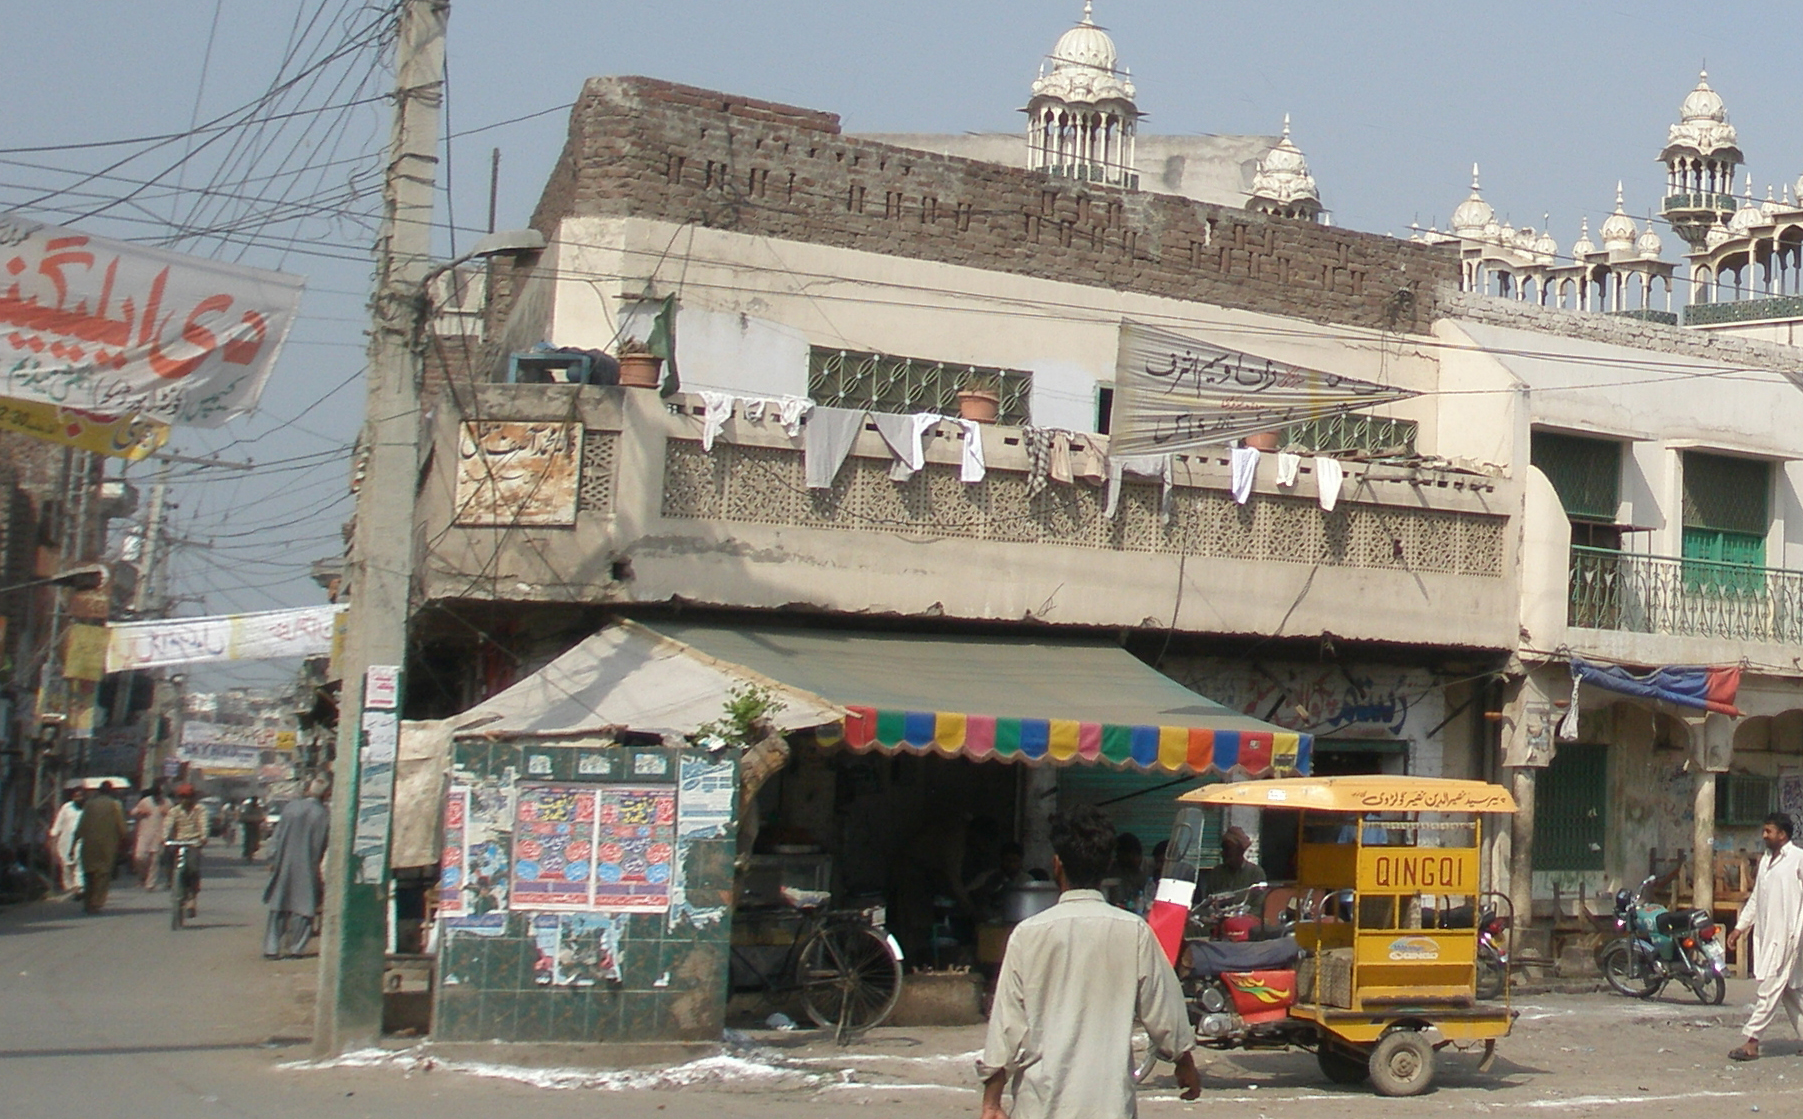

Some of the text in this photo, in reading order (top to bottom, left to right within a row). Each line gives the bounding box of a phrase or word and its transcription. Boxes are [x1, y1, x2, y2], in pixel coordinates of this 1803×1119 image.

[149, 293, 266, 379] دی
[1145, 350, 1199, 395] اشرف
[1376, 856, 1462, 887] QINGQI
